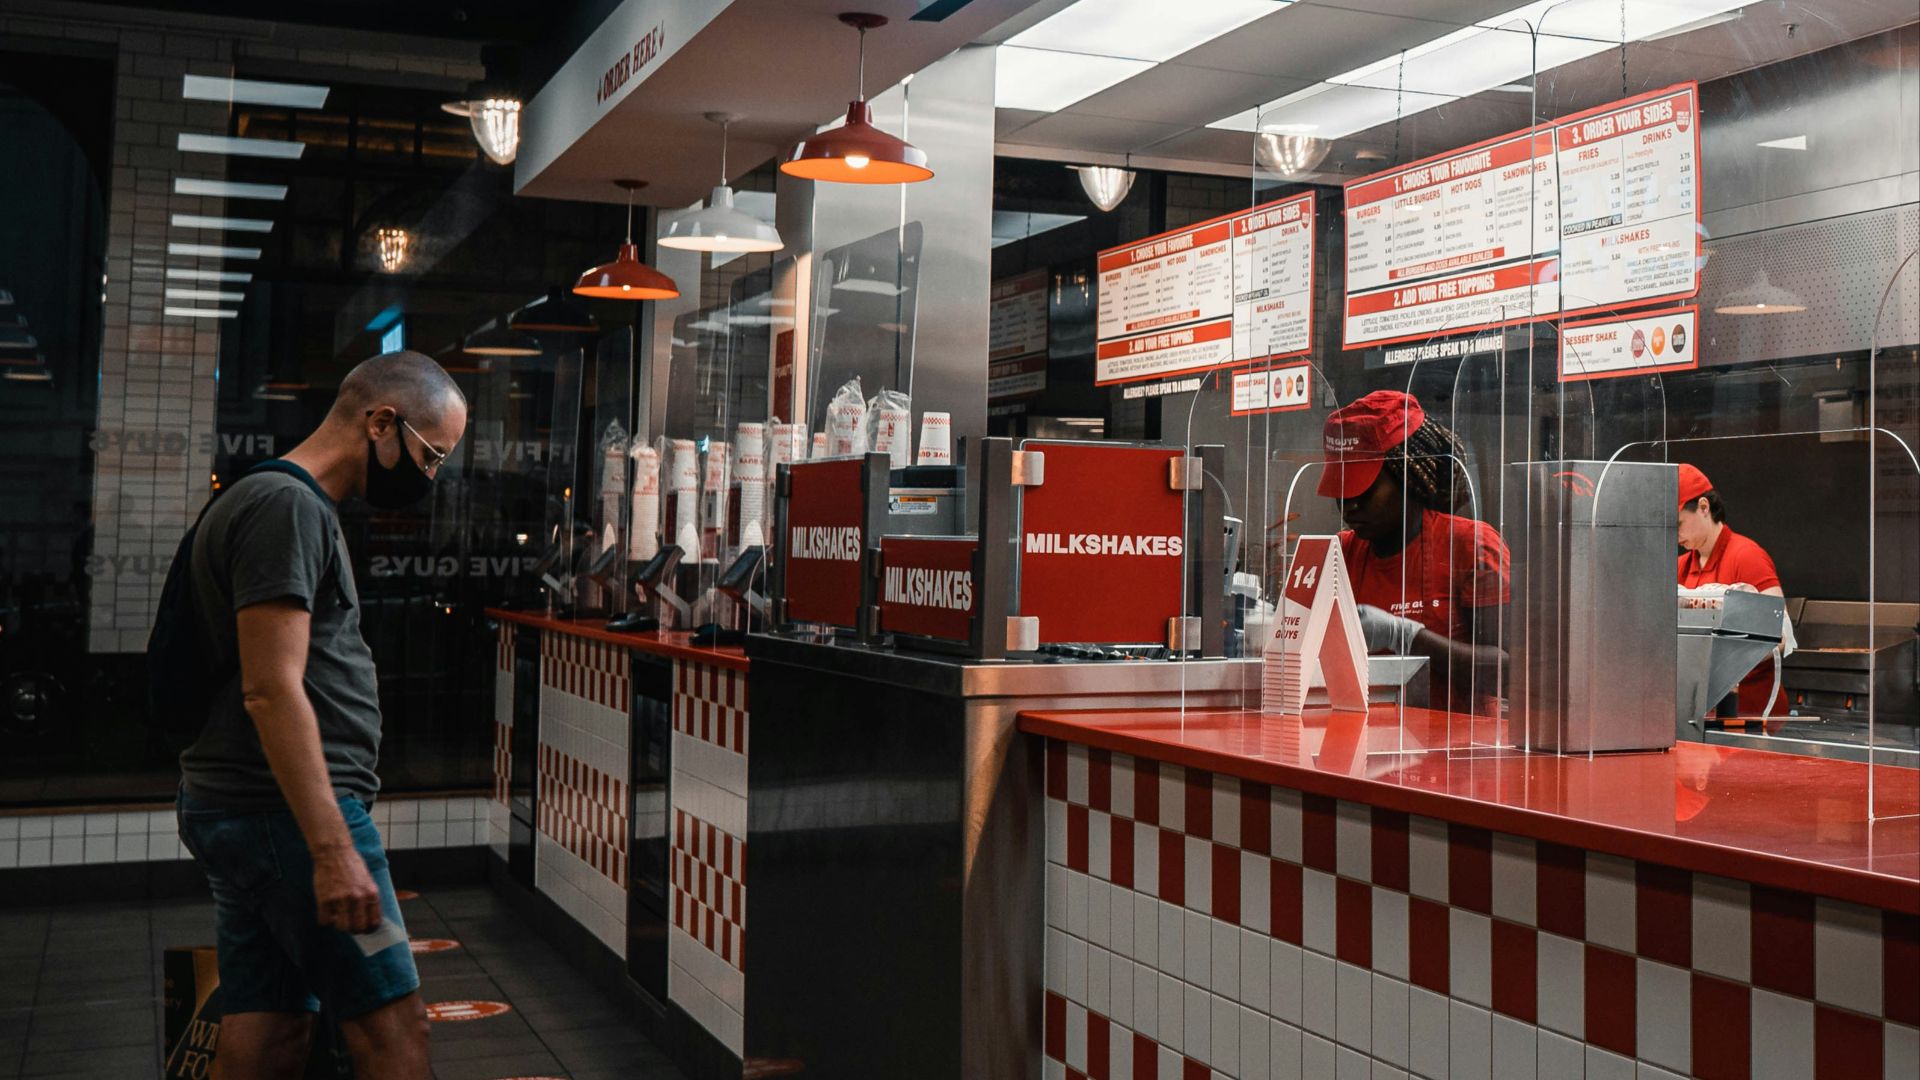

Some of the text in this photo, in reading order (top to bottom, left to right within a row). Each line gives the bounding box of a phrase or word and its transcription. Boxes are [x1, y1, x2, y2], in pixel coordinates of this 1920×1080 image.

[603, 25, 658, 101] ORDER HERE
[1572, 127, 1582, 144] 3.
[1583, 118, 1615, 141] ORDER
[1615, 109, 1641, 132] YOUR
[1643, 100, 1673, 126] SIDES
[1642, 128, 1672, 144] DRINKS
[1578, 147, 1599, 161] FRIES
[1394, 150, 1492, 193] 1. CHOOSE YOUR FAVOURITE
[1503, 160, 1547, 181] SANDWICHES
[1450, 178, 1482, 195] HOT DOGS
[1394, 189, 1440, 210] LITTLE BURGERS
[1282, 203, 1300, 222] SIDES
[1357, 205, 1381, 219] BURGERS
[1281, 225, 1299, 237] DRINKS
[1592, 216, 1612, 230] PEANUT
[1200, 244, 1226, 258] SANDWICHES
[1143, 261, 1161, 273] BURGERS
[1167, 255, 1187, 266] HOT DOGS
[1393, 272, 1495, 307] 2. ADD YOUR FREE TOPPINGS
[1256, 301, 1285, 313] MILKSHAKES
[1158, 333, 1170, 347] FREE
[1565, 331, 1617, 346] DESSERT SHAKE
[1384, 347, 1417, 365] ALLERGIES?
[1418, 344, 1439, 360] PLEASE
[1439, 340, 1459, 357] SPEAK
[1460, 339, 1469, 355] TO
[1334, 437, 1359, 446] GUYS
[792, 525, 861, 562] MILKSHAKES
[1026, 532, 1183, 557] MILKSHAKES
[1293, 565, 1318, 589] 14
[884, 565, 972, 611] MILKSHAKES
[1390, 602, 1410, 611] FIVE
[1281, 616, 1301, 626] FIVE
